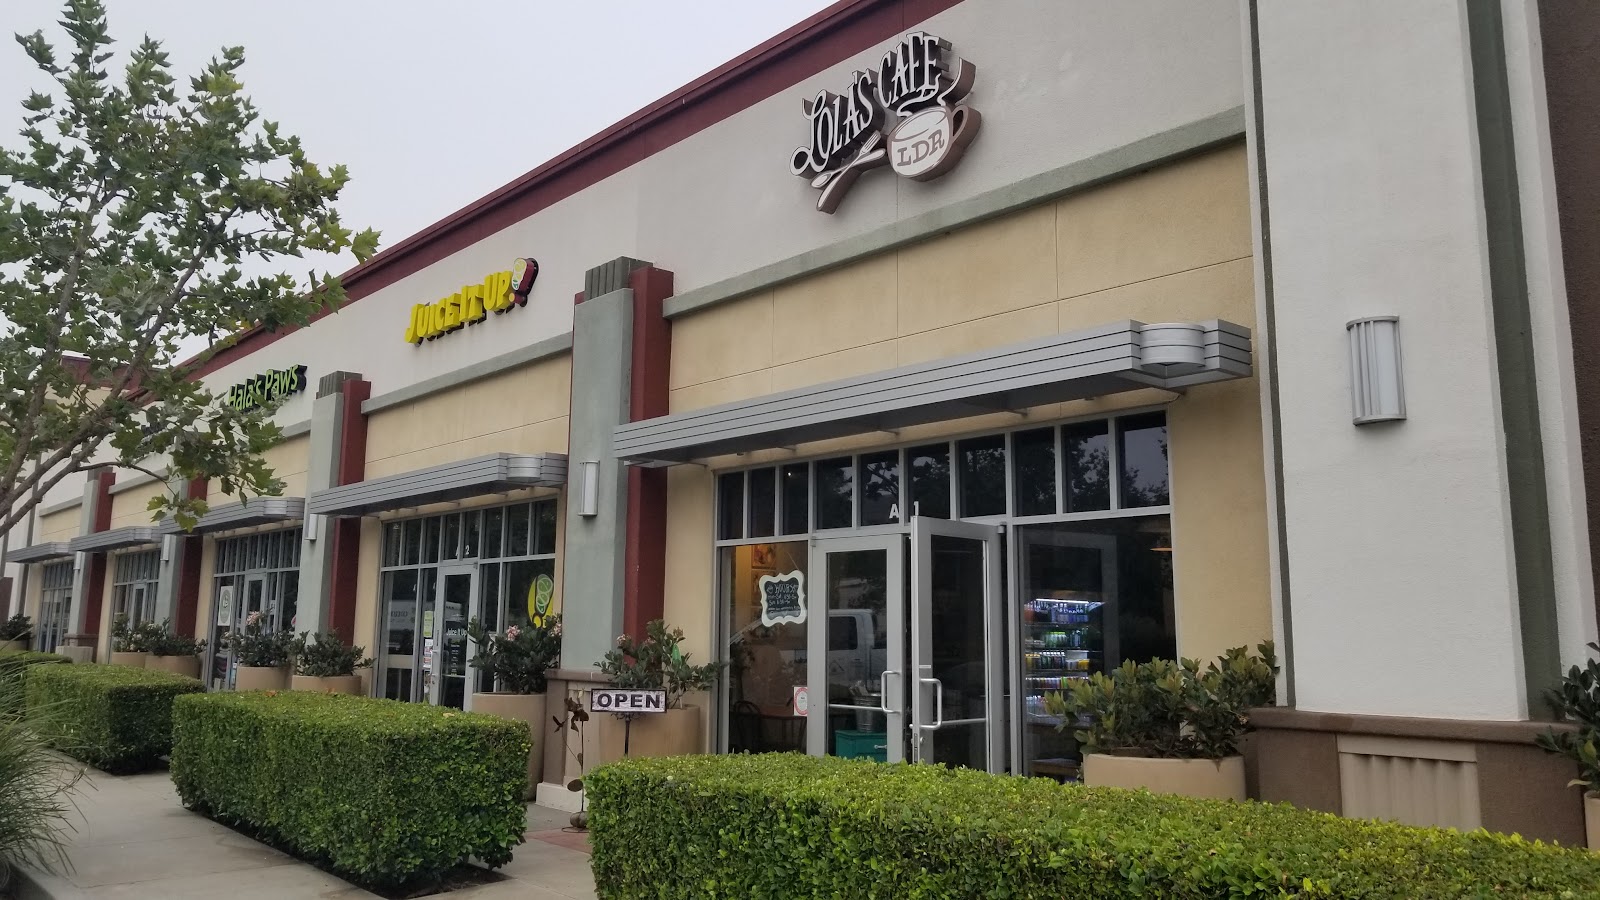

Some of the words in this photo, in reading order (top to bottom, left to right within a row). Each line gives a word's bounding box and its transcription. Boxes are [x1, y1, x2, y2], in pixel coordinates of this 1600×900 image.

[789, 68, 874, 176] LOLA'S
[877, 31, 945, 108] CAFE
[897, 129, 945, 167] LDR
[404, 293, 461, 343] JUICE
[459, 284, 484, 323] IT
[227, 373, 263, 412] Hala's
[264, 364, 299, 401] Paws
[597, 693, 660, 708] OPEN
